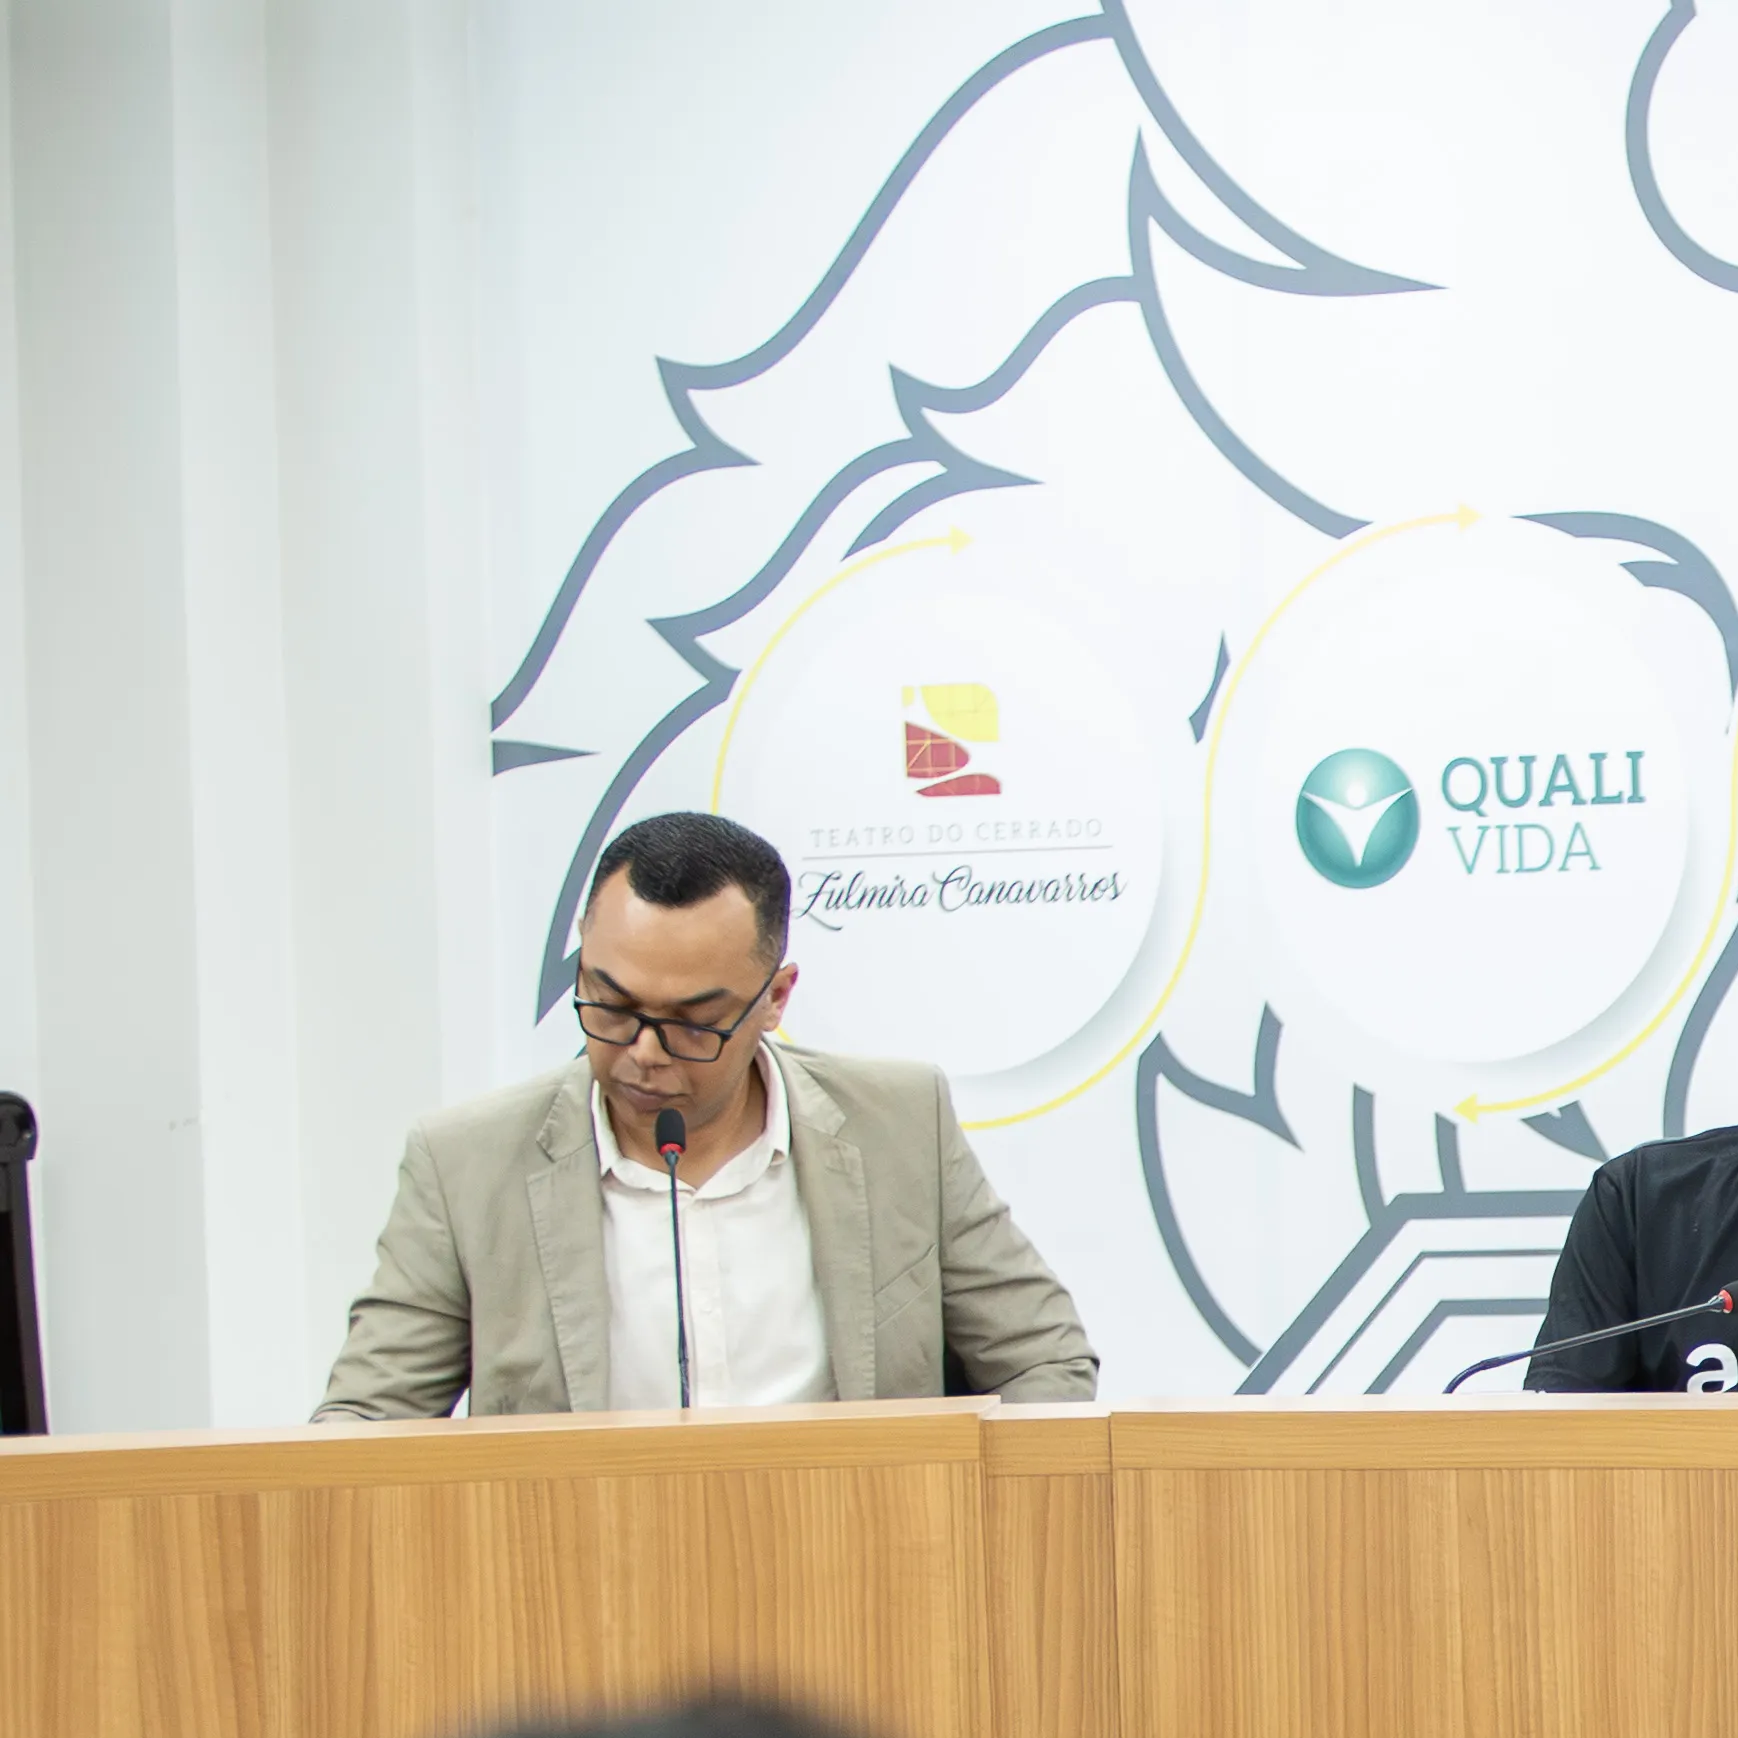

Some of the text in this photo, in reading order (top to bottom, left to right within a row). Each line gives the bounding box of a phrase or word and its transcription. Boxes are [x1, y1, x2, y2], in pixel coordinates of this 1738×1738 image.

[1441, 751, 1646, 817] QUALI
[810, 818, 1103, 848] TEATRO DO CERRADO
[1447, 822, 1601, 875] VIDA
[931, 865, 1126, 912] Canavarros
